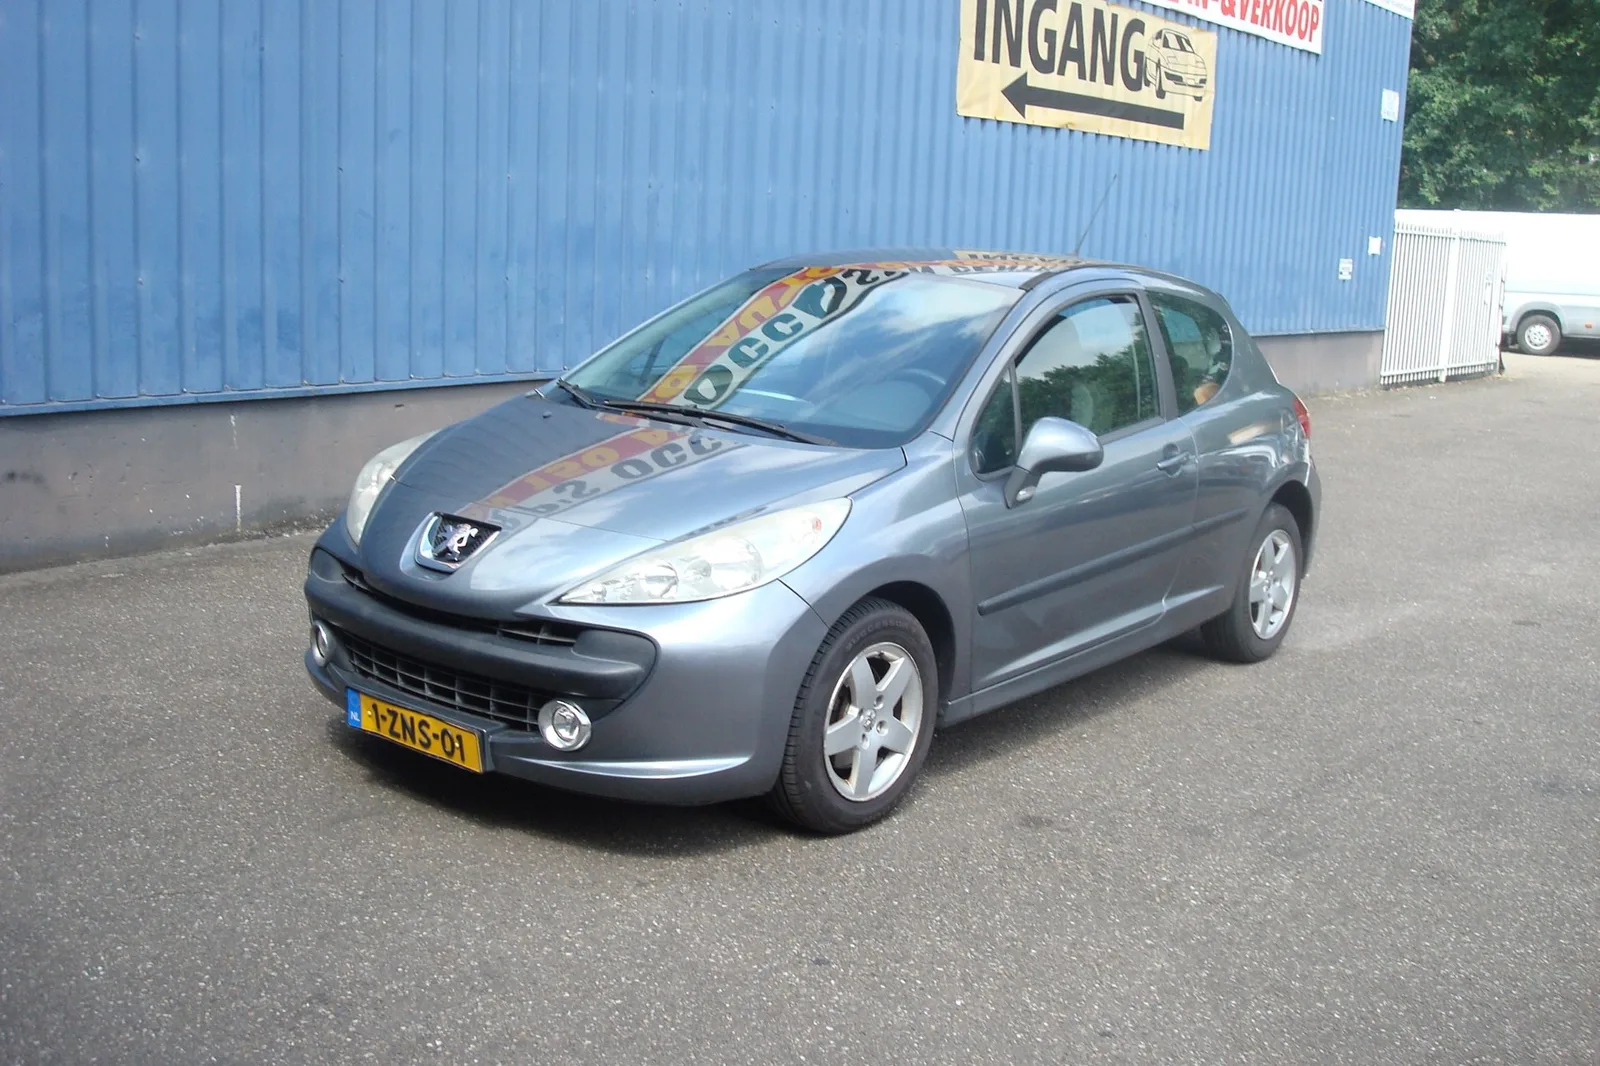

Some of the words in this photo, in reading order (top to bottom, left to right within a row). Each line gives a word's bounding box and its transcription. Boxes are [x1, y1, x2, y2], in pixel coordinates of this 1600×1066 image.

[973, 0, 1148, 92] INGANG
[350, 710, 361, 722] NL
[371, 702, 466, 763] 1-ZNS-01
